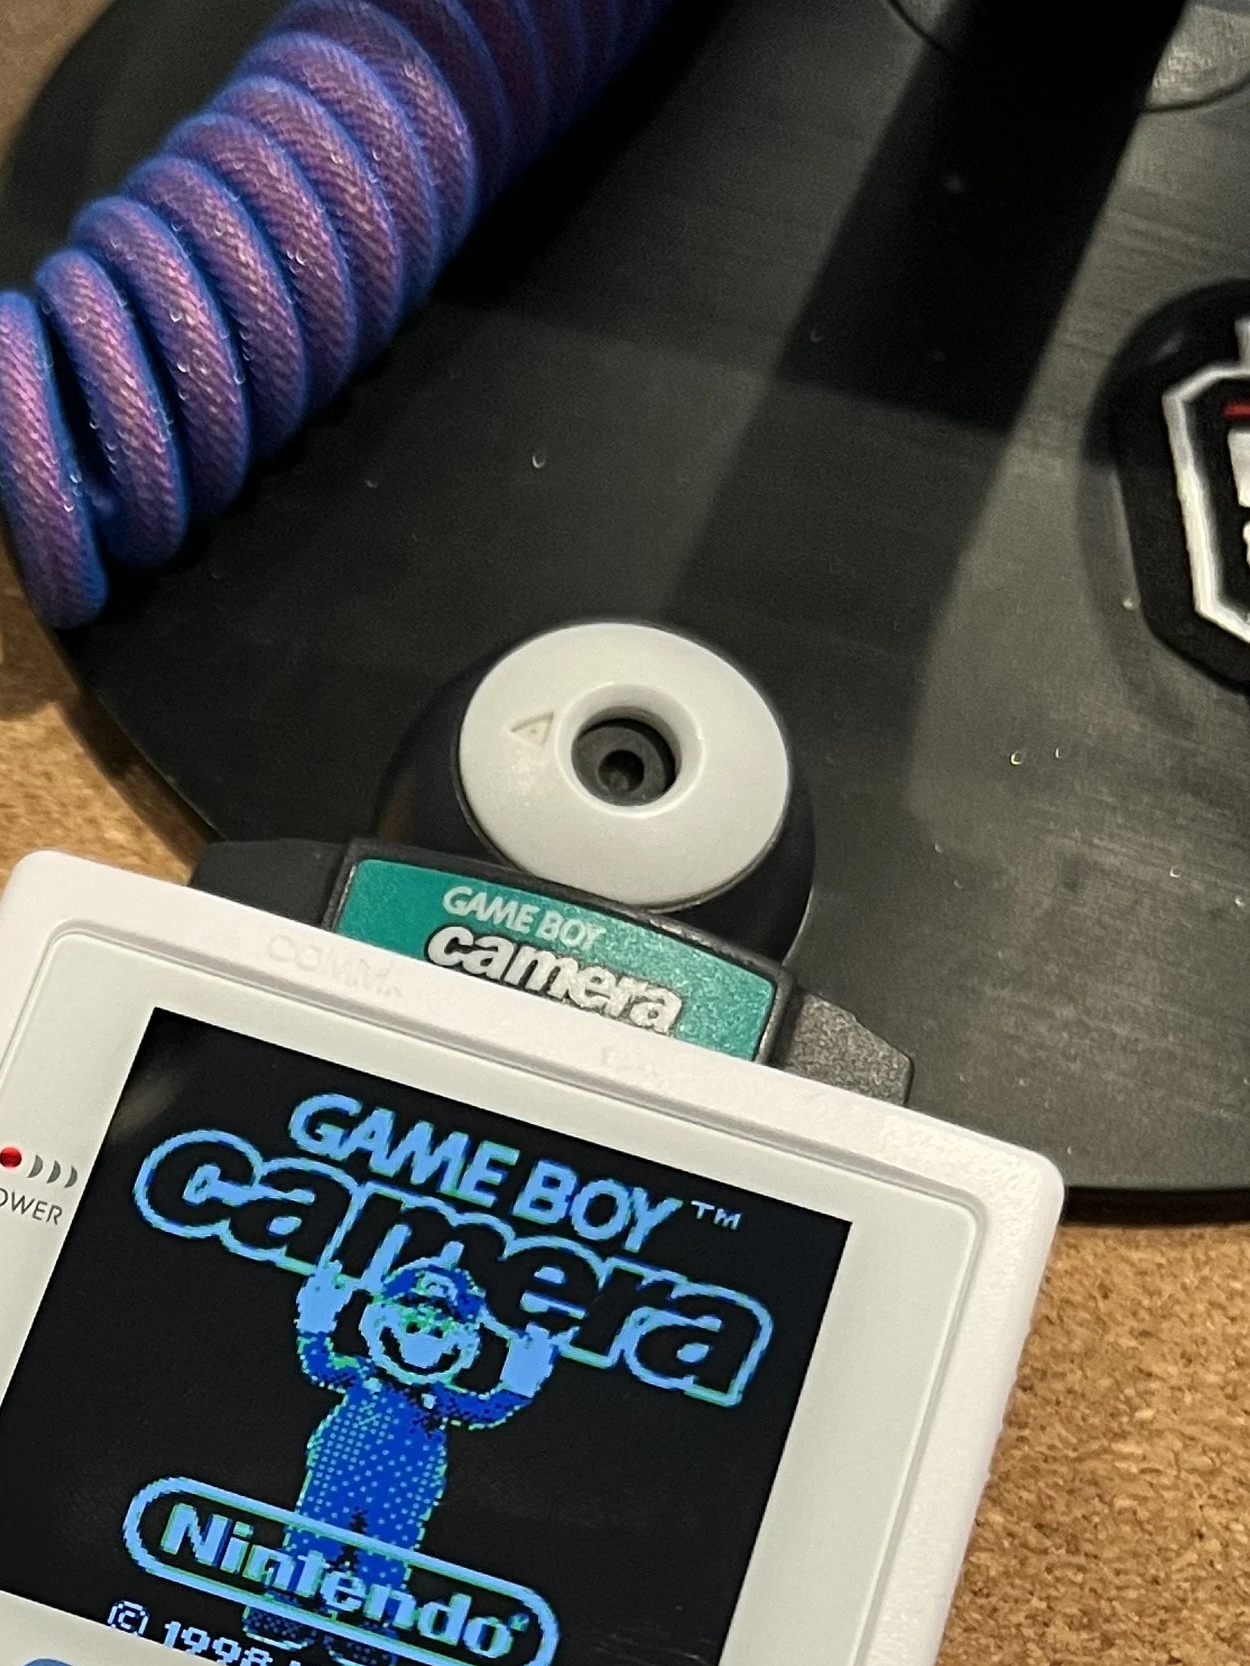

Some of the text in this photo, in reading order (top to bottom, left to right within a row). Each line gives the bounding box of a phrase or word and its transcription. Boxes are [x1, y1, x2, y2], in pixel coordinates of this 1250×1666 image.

[425, 922, 684, 1038] camera
[442, 885, 606, 951] GAME BOY
[289, 1093, 518, 1207] GAME
[516, 1160, 683, 1252] BOY
[135, 1130, 772, 1407] camera
[161, 1502, 514, 1660] Nintendo
